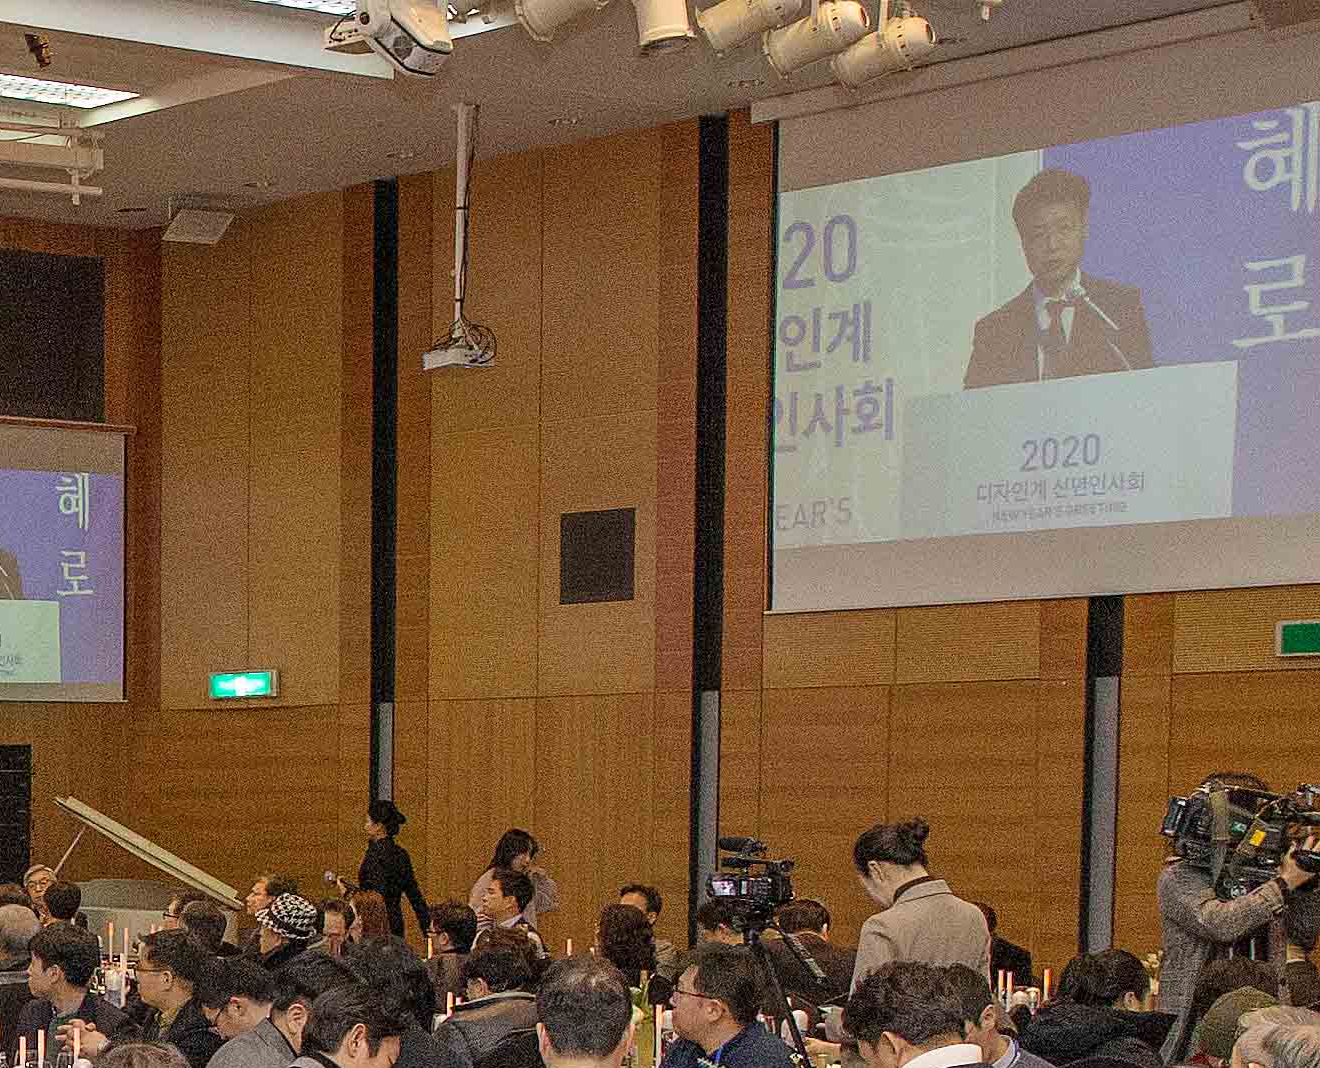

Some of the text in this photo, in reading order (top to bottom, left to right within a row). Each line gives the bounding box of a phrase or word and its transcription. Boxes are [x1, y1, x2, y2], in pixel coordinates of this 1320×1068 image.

[782, 214, 858, 289] 20
[1022, 434, 1100, 471] 2020
[977, 472, 1145, 504] 디자인계 신년인사회
